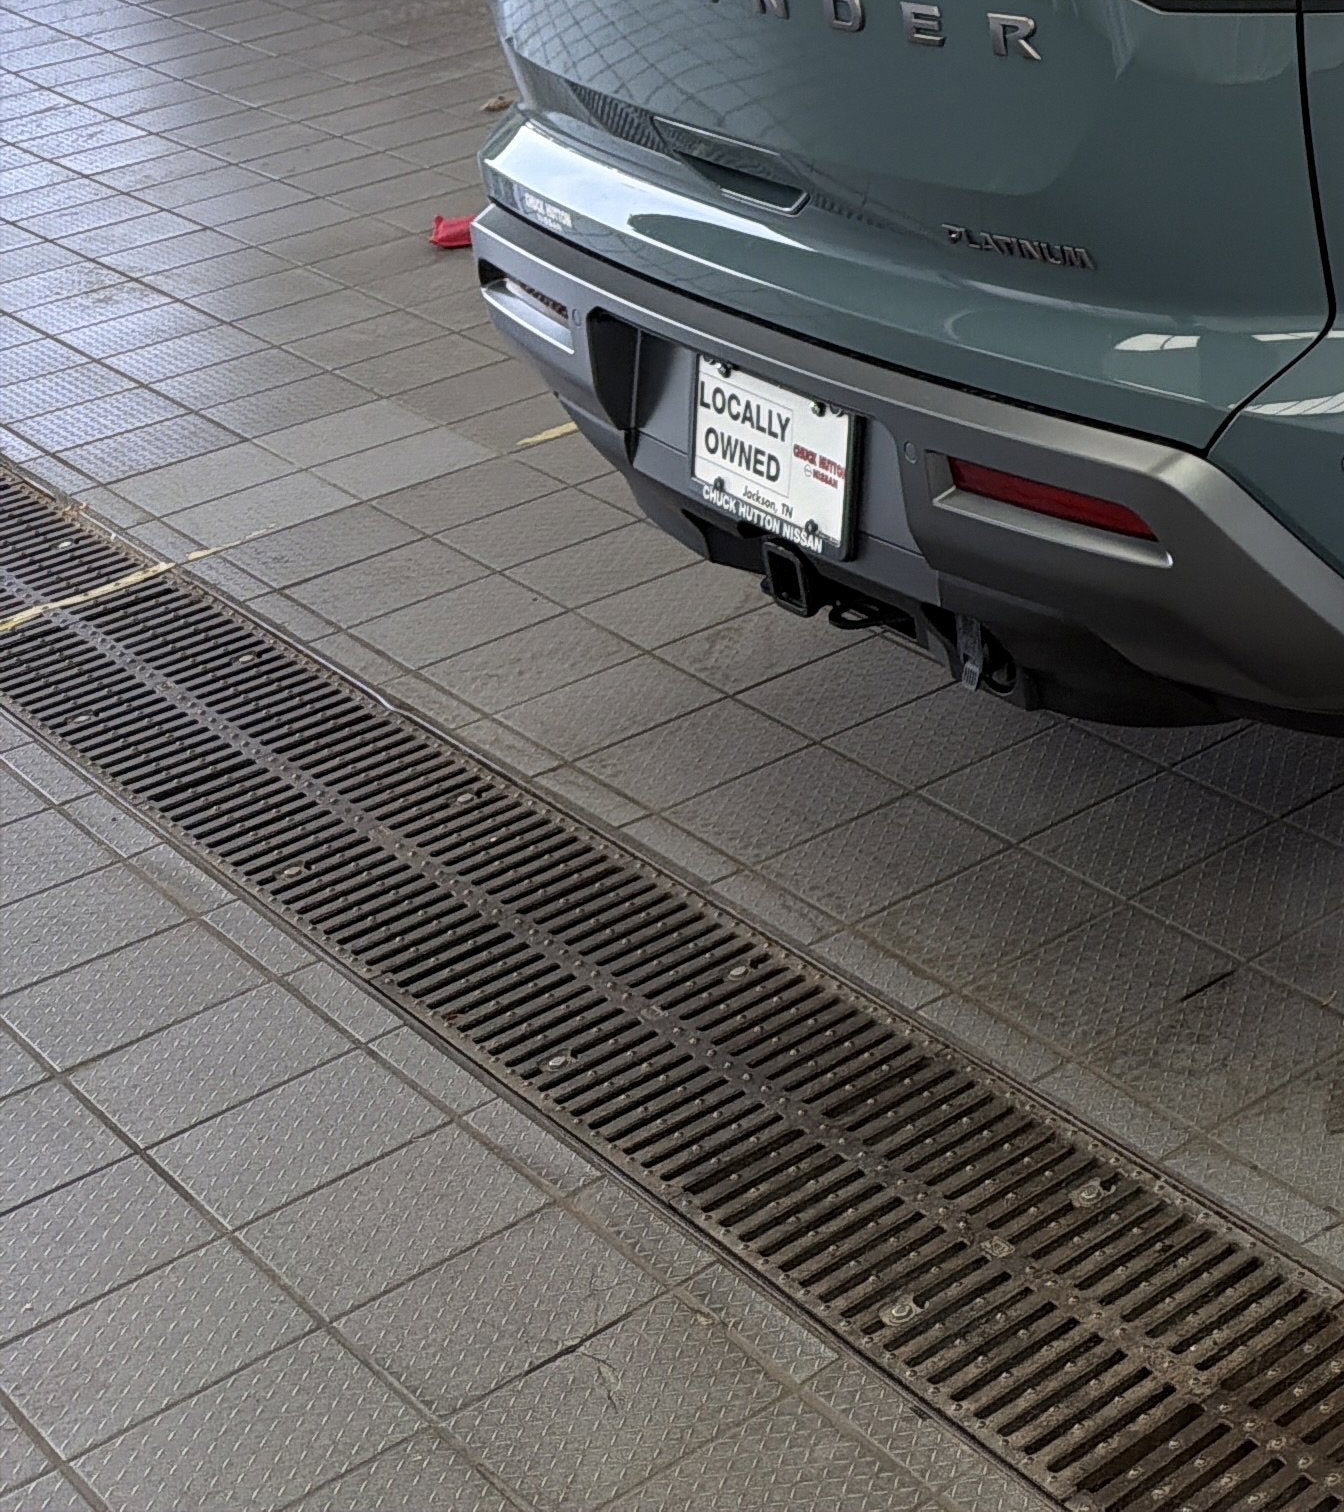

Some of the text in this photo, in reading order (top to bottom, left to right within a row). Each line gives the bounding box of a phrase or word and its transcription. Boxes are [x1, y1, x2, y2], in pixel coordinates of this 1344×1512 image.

[941, 223, 1096, 270] PLATINUM
[700, 380, 791, 442] LOCALLY
[705, 427, 781, 483] OWNED
[793, 443, 818, 466] CHUCK
[702, 485, 823, 554] CHUCK HUTTON NISSAN
[743, 486, 794, 519] Jackson, TN
